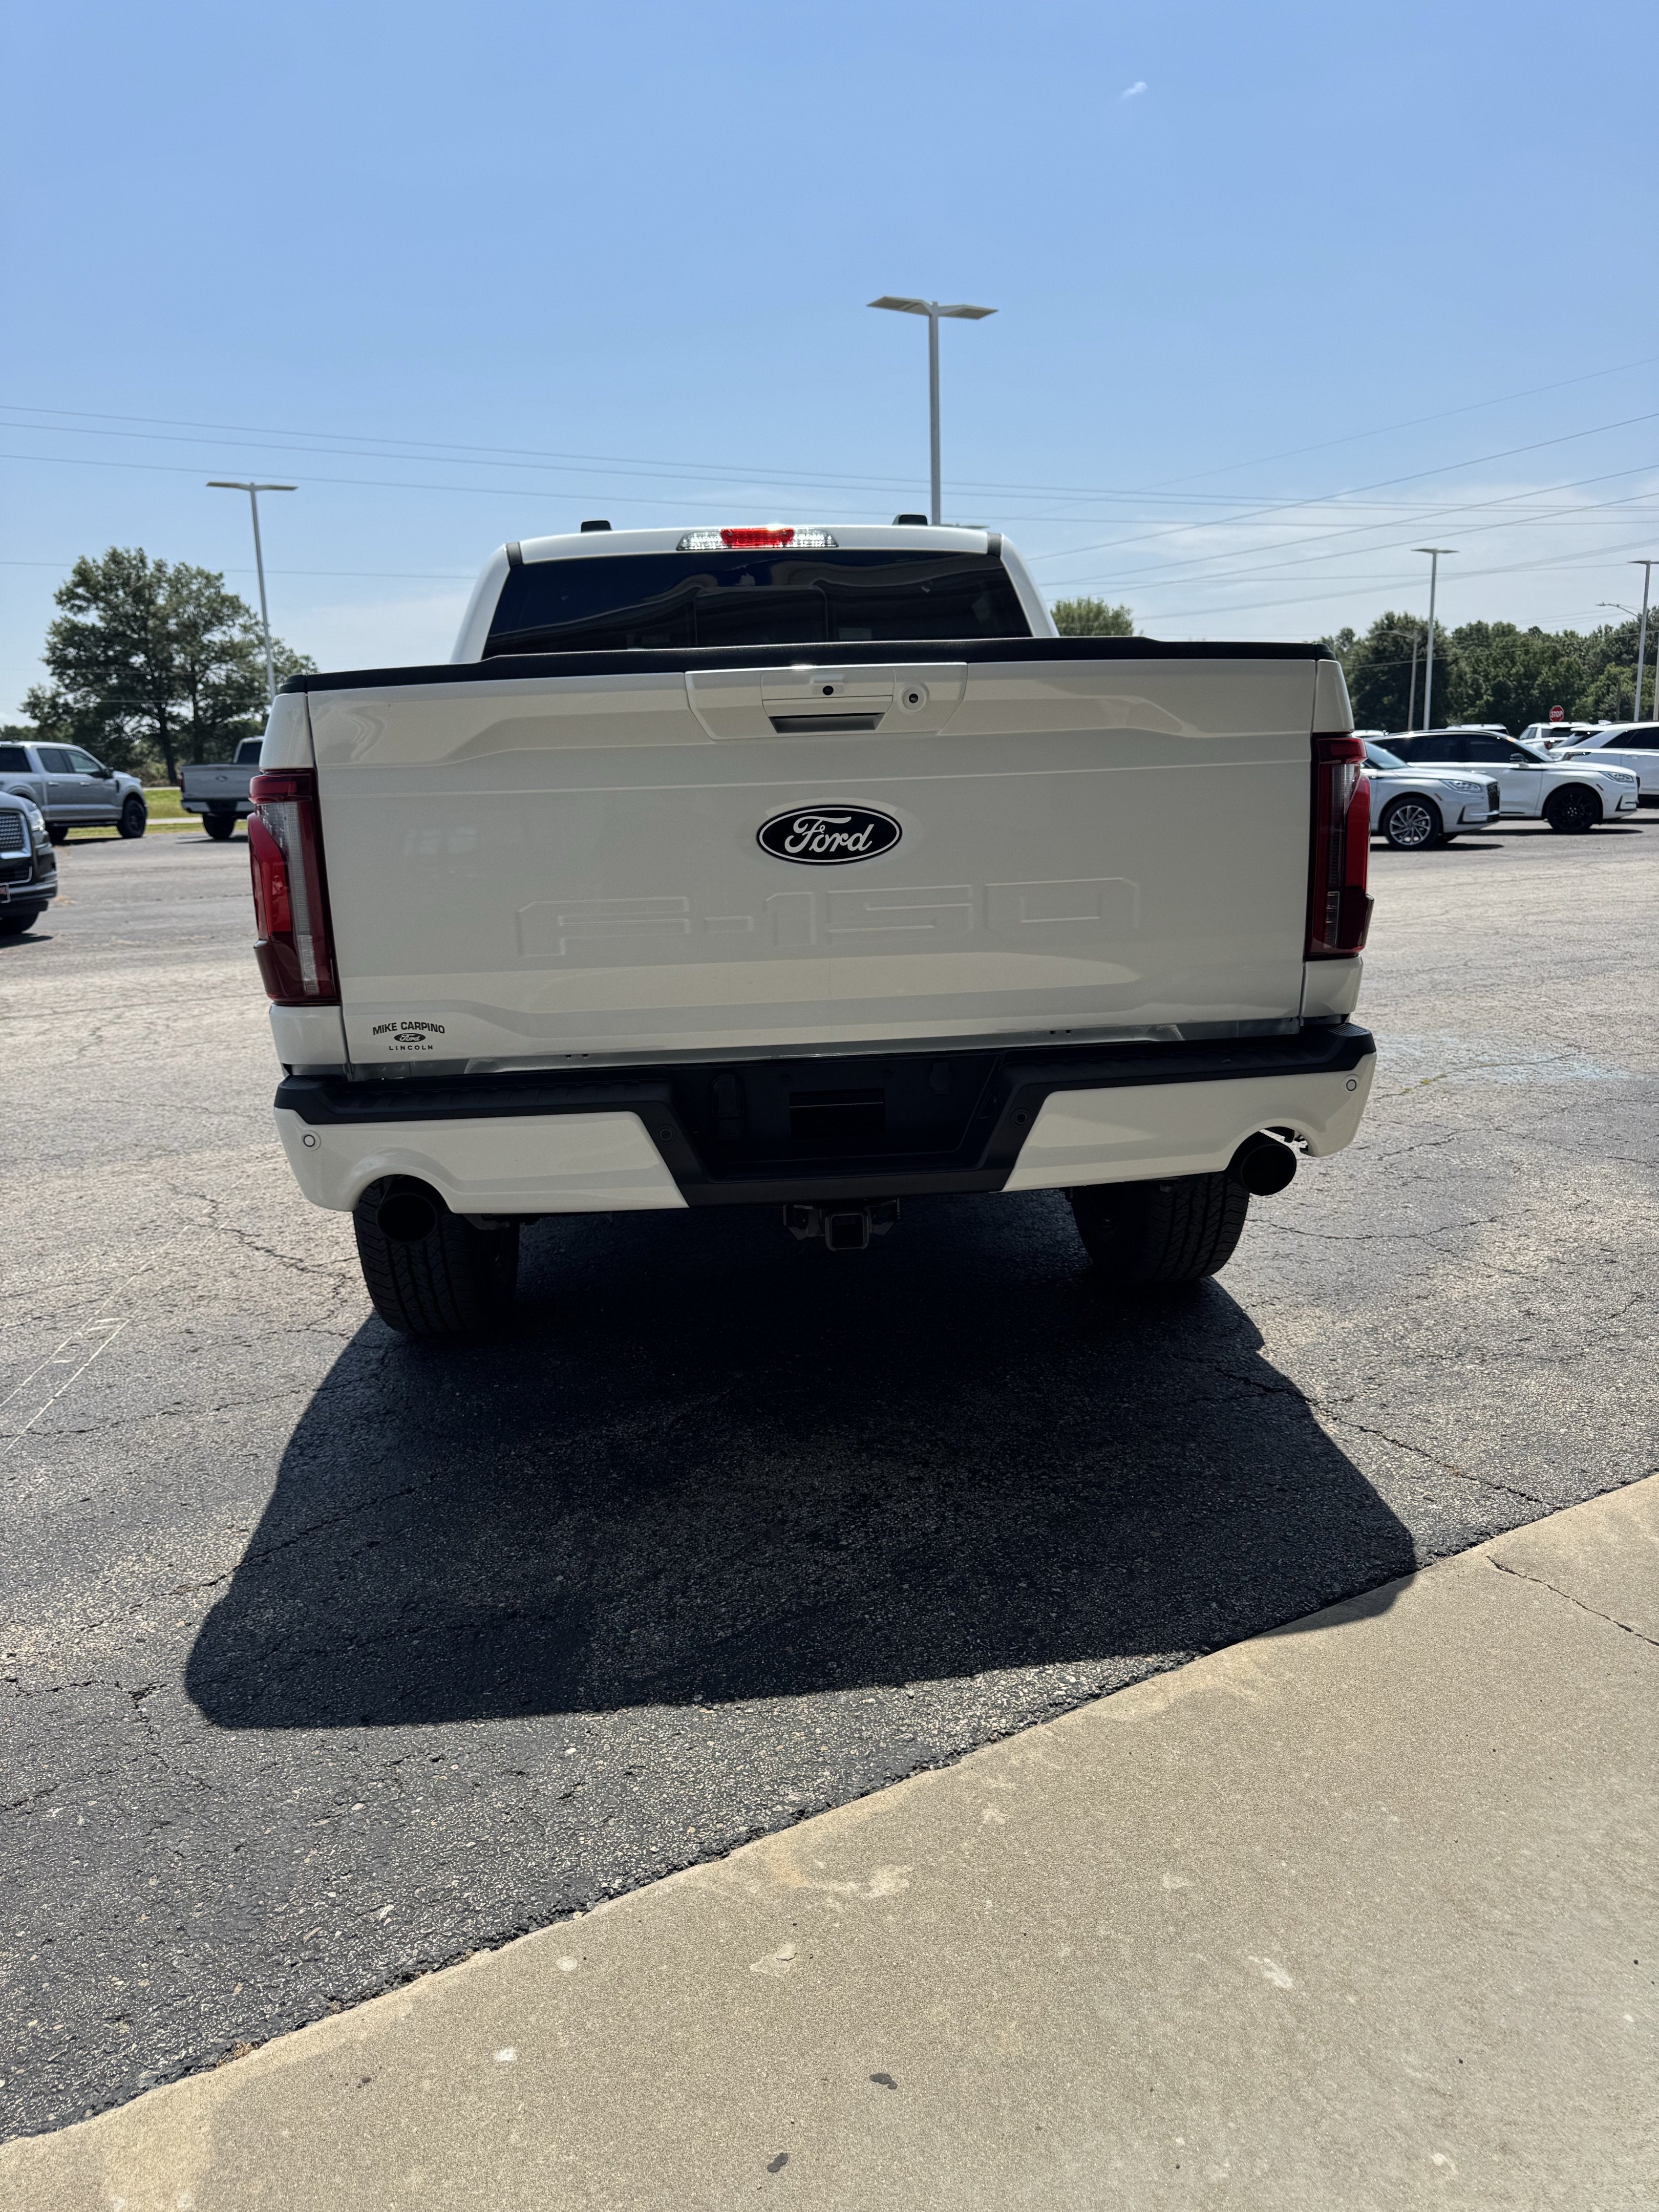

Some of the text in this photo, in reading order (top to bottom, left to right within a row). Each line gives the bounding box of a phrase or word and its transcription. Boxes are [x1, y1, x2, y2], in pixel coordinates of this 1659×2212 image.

[784, 816, 875, 853] Ford
[516, 878, 1141, 958] F-150
[372, 1021, 445, 1035] MIKE CARPINO
